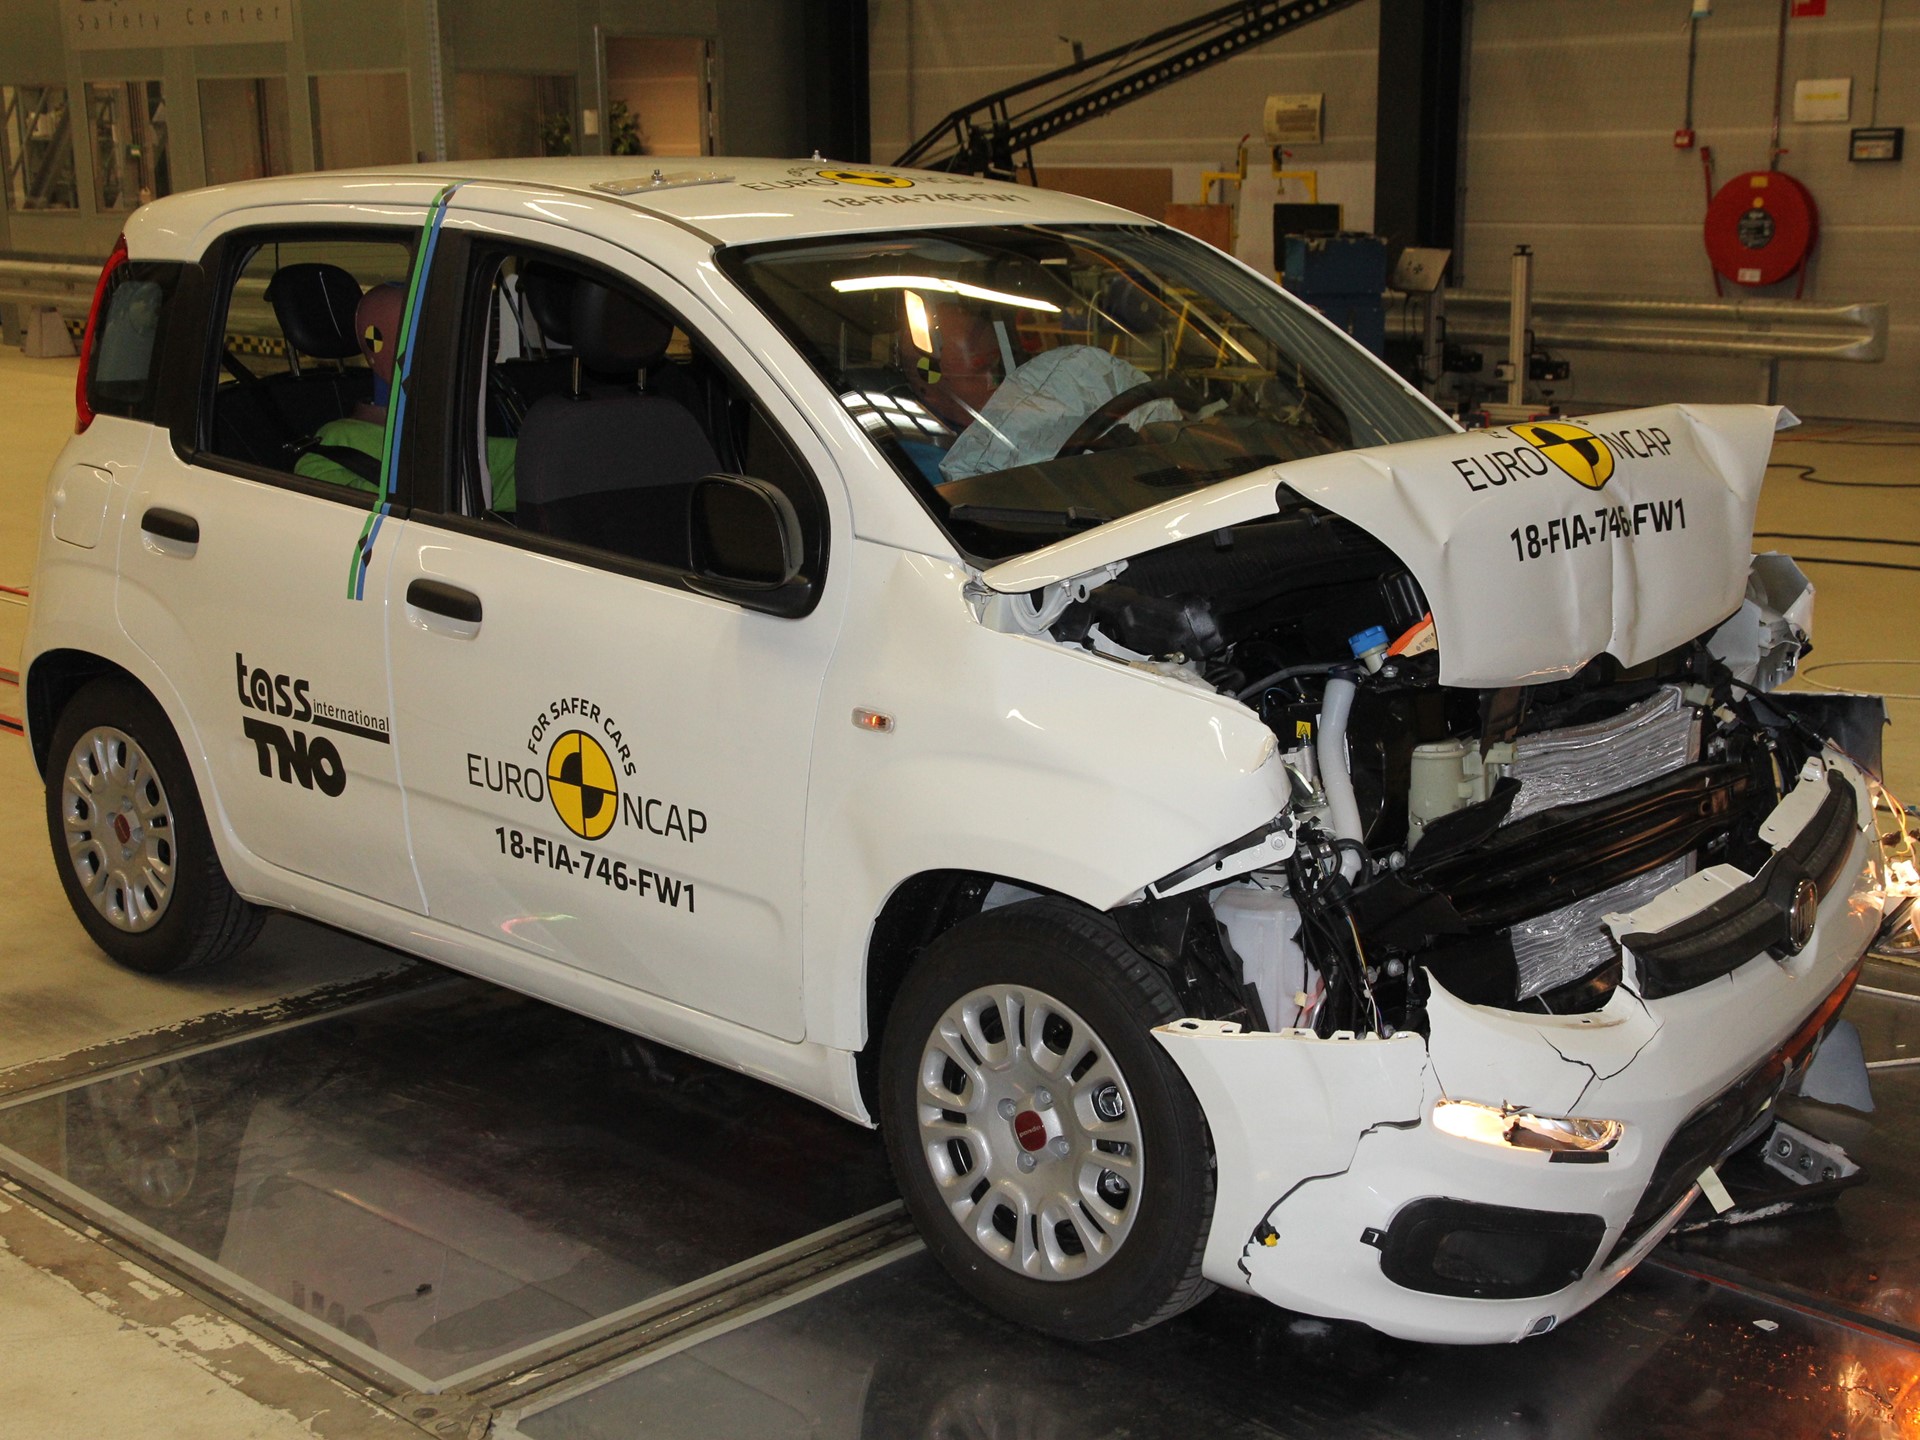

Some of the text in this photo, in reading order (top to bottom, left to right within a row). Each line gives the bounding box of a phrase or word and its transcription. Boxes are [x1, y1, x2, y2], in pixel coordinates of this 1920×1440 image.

[77, 6, 280, 32] Safety Center
[741, 177, 839, 193] EURO
[1451, 427, 1672, 492] EURO NCAP
[1510, 498, 1687, 562] 18-FIA-746-FW1
[235, 652, 390, 732] tass international
[242, 715, 347, 798] TNO
[527, 697, 637, 777] FOR SAFER CARS
[466, 752, 708, 844] EURO NCAP
[495, 826, 696, 914] 18-FIA-746-FW1
